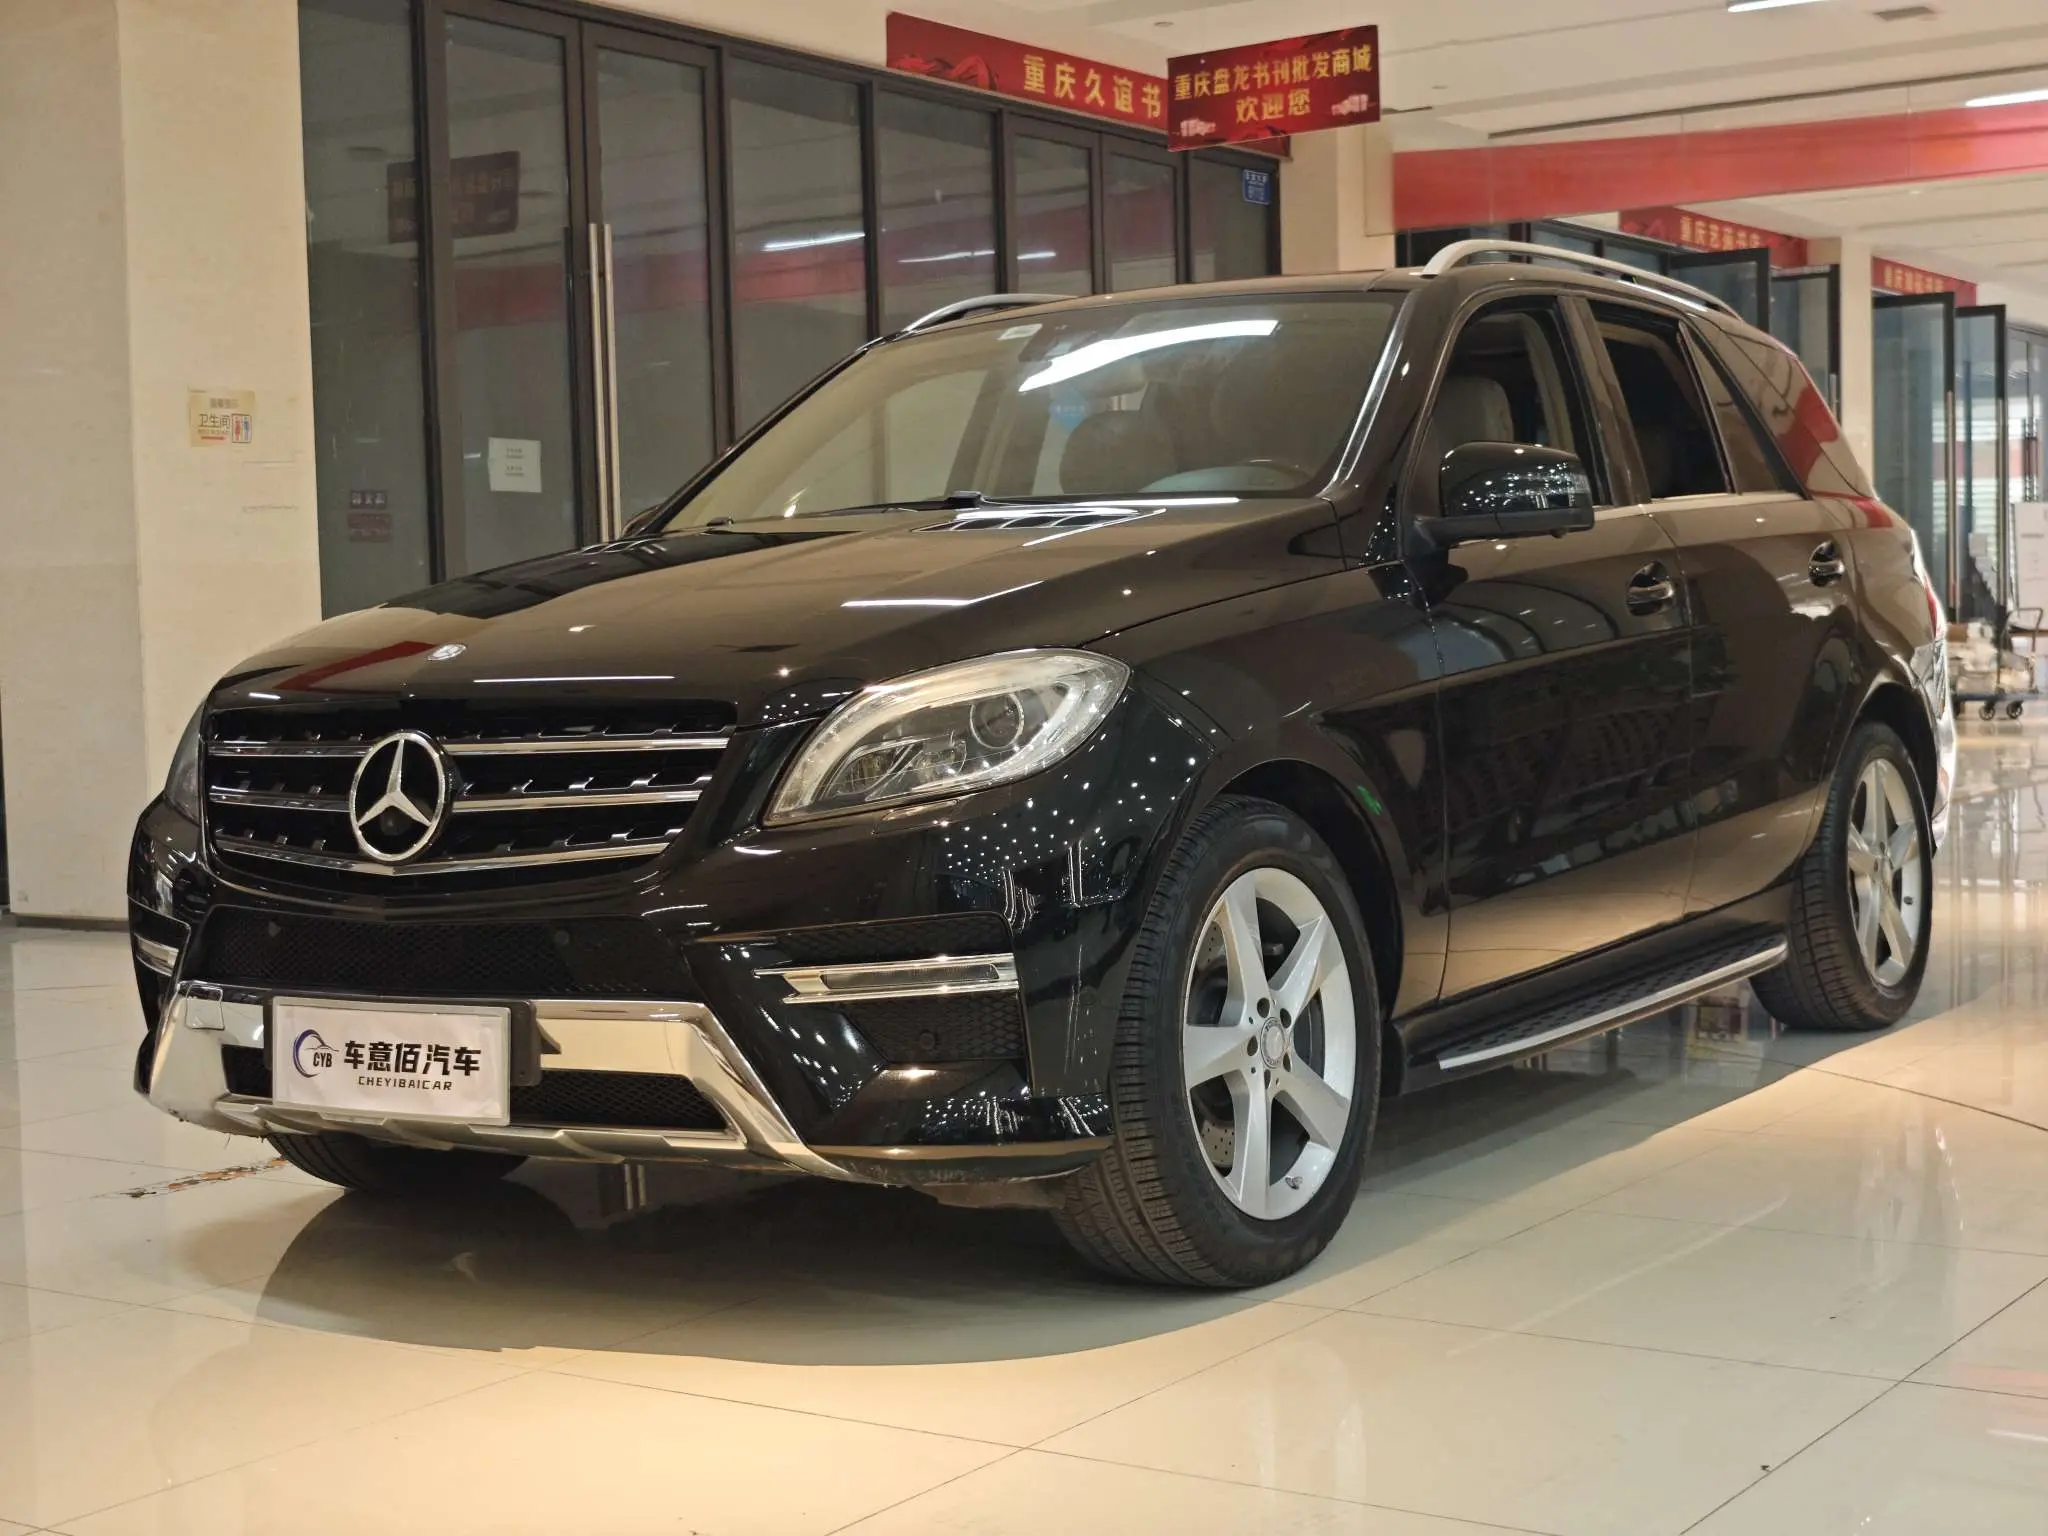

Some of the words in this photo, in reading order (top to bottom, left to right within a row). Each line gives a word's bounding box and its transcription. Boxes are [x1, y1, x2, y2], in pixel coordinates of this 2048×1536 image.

[1023, 54, 1162, 119] 重庆久谊书
[1174, 43, 1373, 101] 重庆盘龙书刊批发商城
[1235, 88, 1311, 123] 欢迎您
[198, 413, 231, 428] 卫生间
[313, 1052, 333, 1068] CYB
[344, 1040, 482, 1077] 车意佰汽车
[358, 1076, 453, 1091] CHEYIBAICAR
